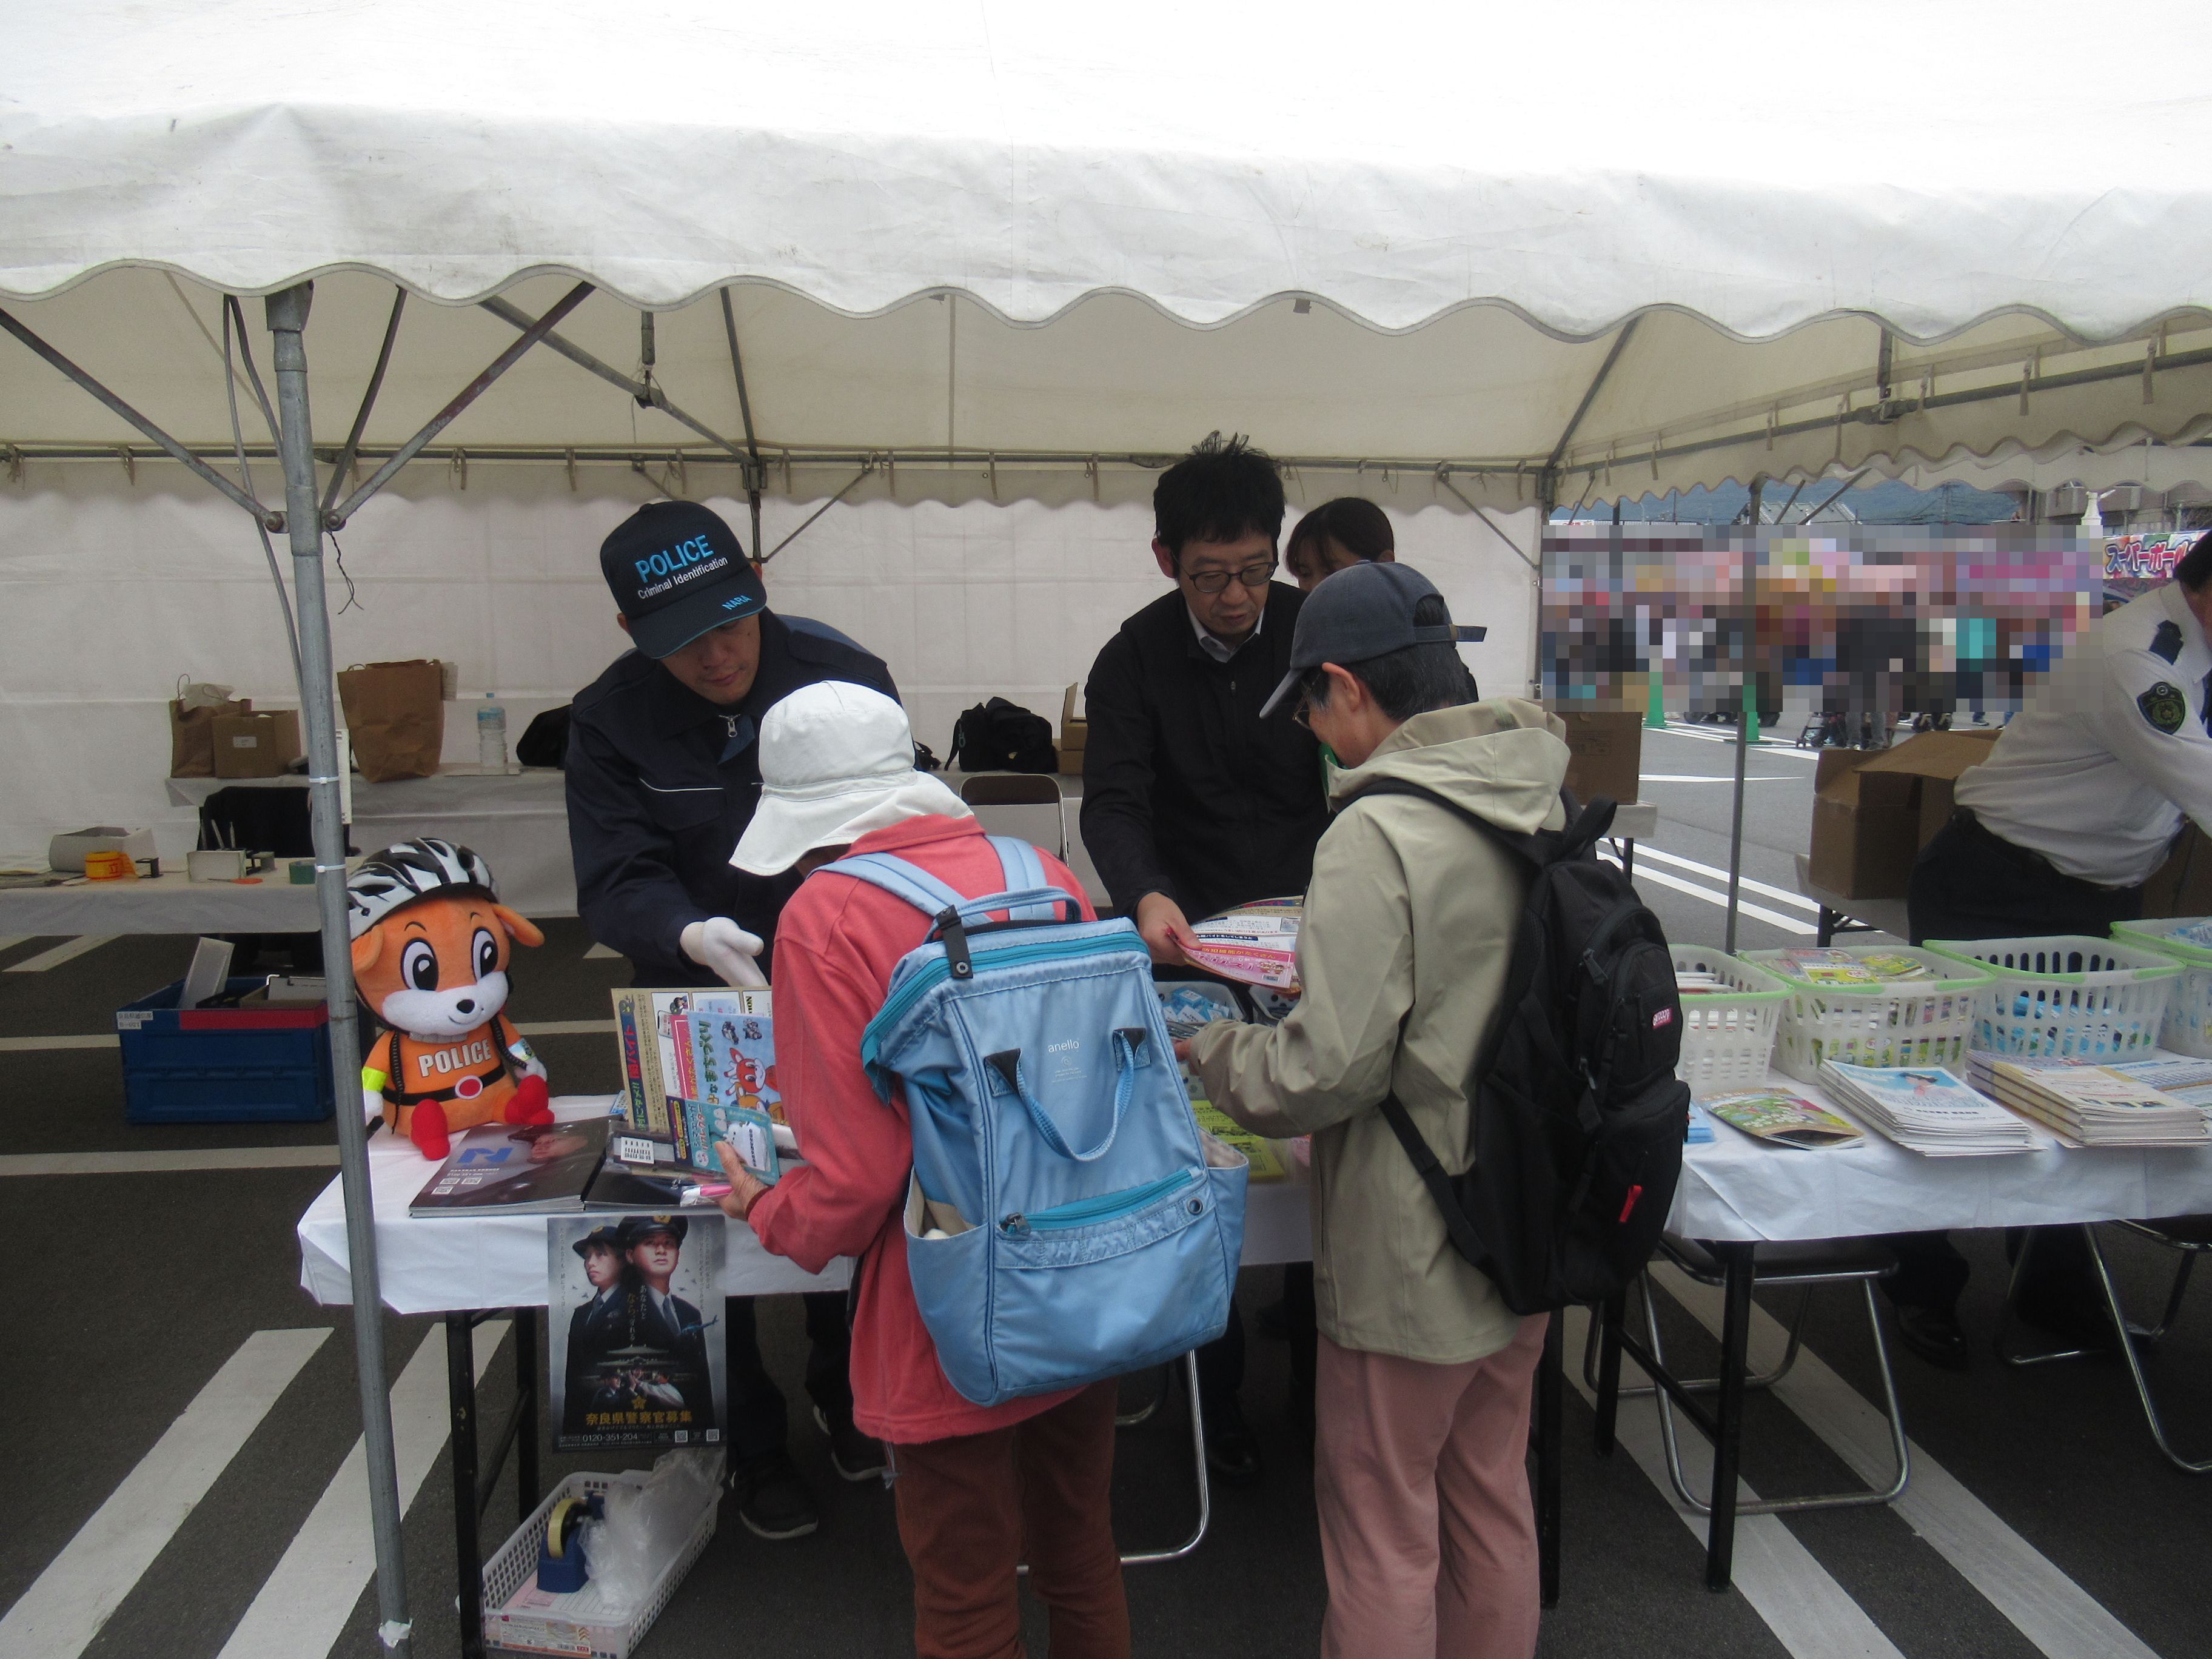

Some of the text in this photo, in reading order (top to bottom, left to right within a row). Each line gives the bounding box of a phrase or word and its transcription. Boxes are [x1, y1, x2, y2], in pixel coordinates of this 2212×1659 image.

[635, 534, 714, 583] POLICE
[638, 556, 728, 600] Criminal Identification
[722, 594, 752, 611] NARA
[418, 1038, 492, 1077] POLICE
[1048, 1039, 1079, 1053] anello
[697, 1104, 709, 1150] リフレクター
[585, 1410, 692, 1426] 奈良県警察官募集
[582, 1433, 638, 1442] 0120-351-204
